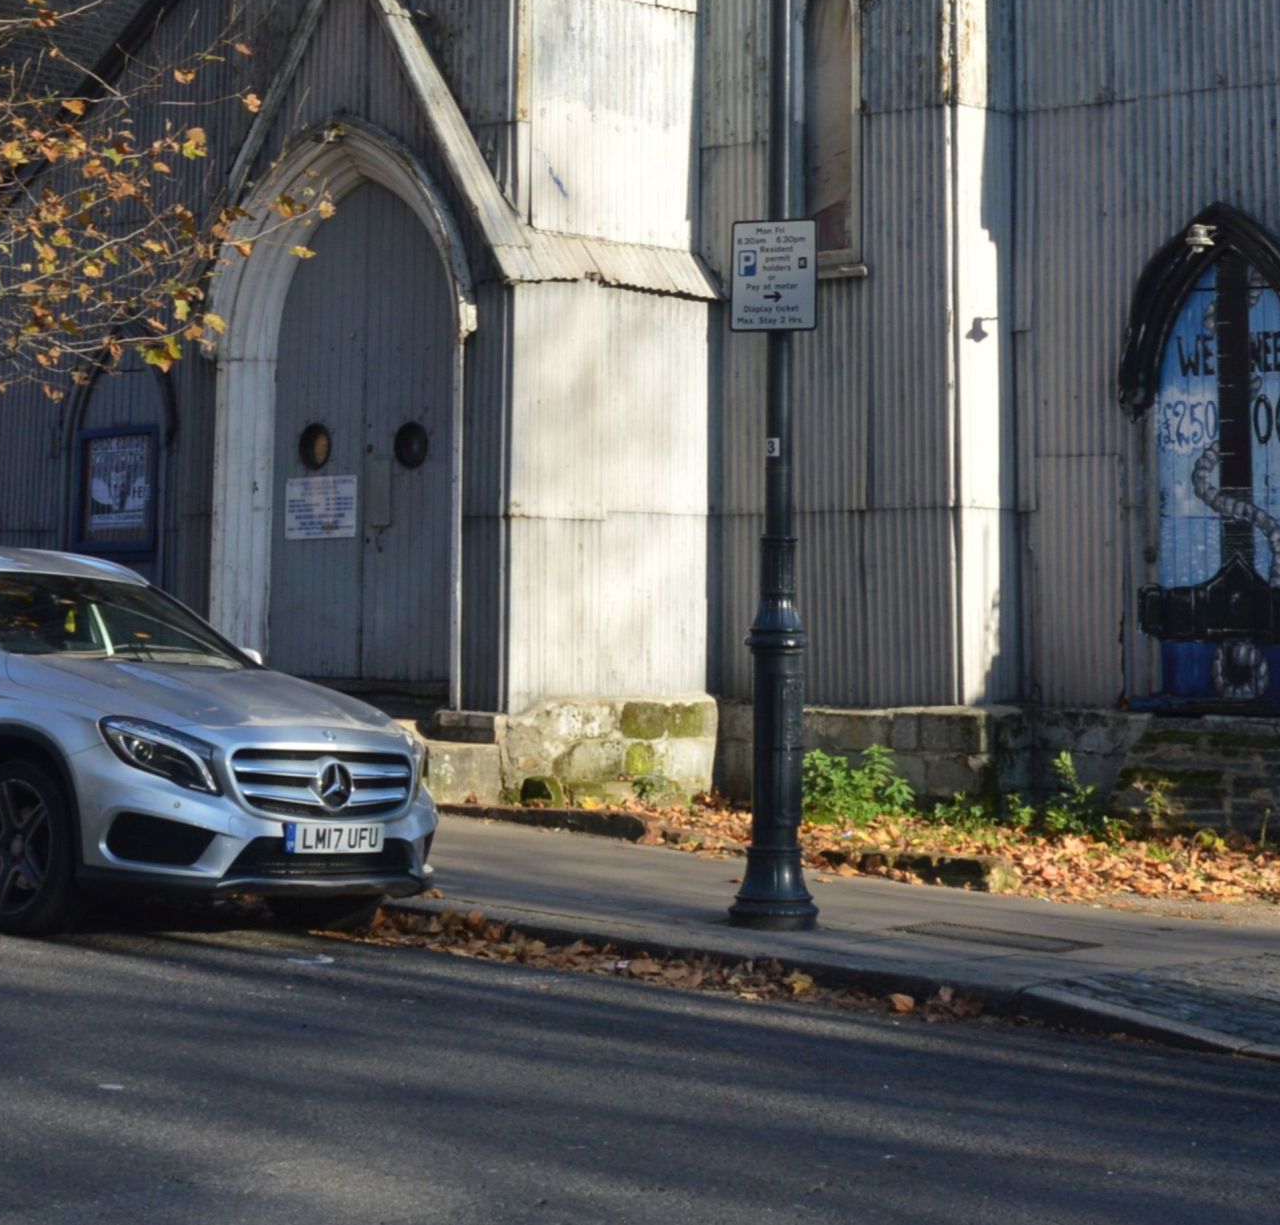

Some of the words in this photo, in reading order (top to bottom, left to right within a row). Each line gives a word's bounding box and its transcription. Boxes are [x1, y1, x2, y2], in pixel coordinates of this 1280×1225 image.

[775, 226, 785, 234] Fri
[760, 245, 793, 253] Resident
[764, 255, 790, 264] permit
[745, 283, 760, 292] Pay
[744, 305, 772, 315] Display
[776, 304, 799, 312] ticket
[759, 316, 777, 325] Stay
[780, 316, 786, 324] 2
[1176, 335, 1216, 376] WE
[302, 827, 343, 849] LM17
[347, 827, 379, 849] UFU
